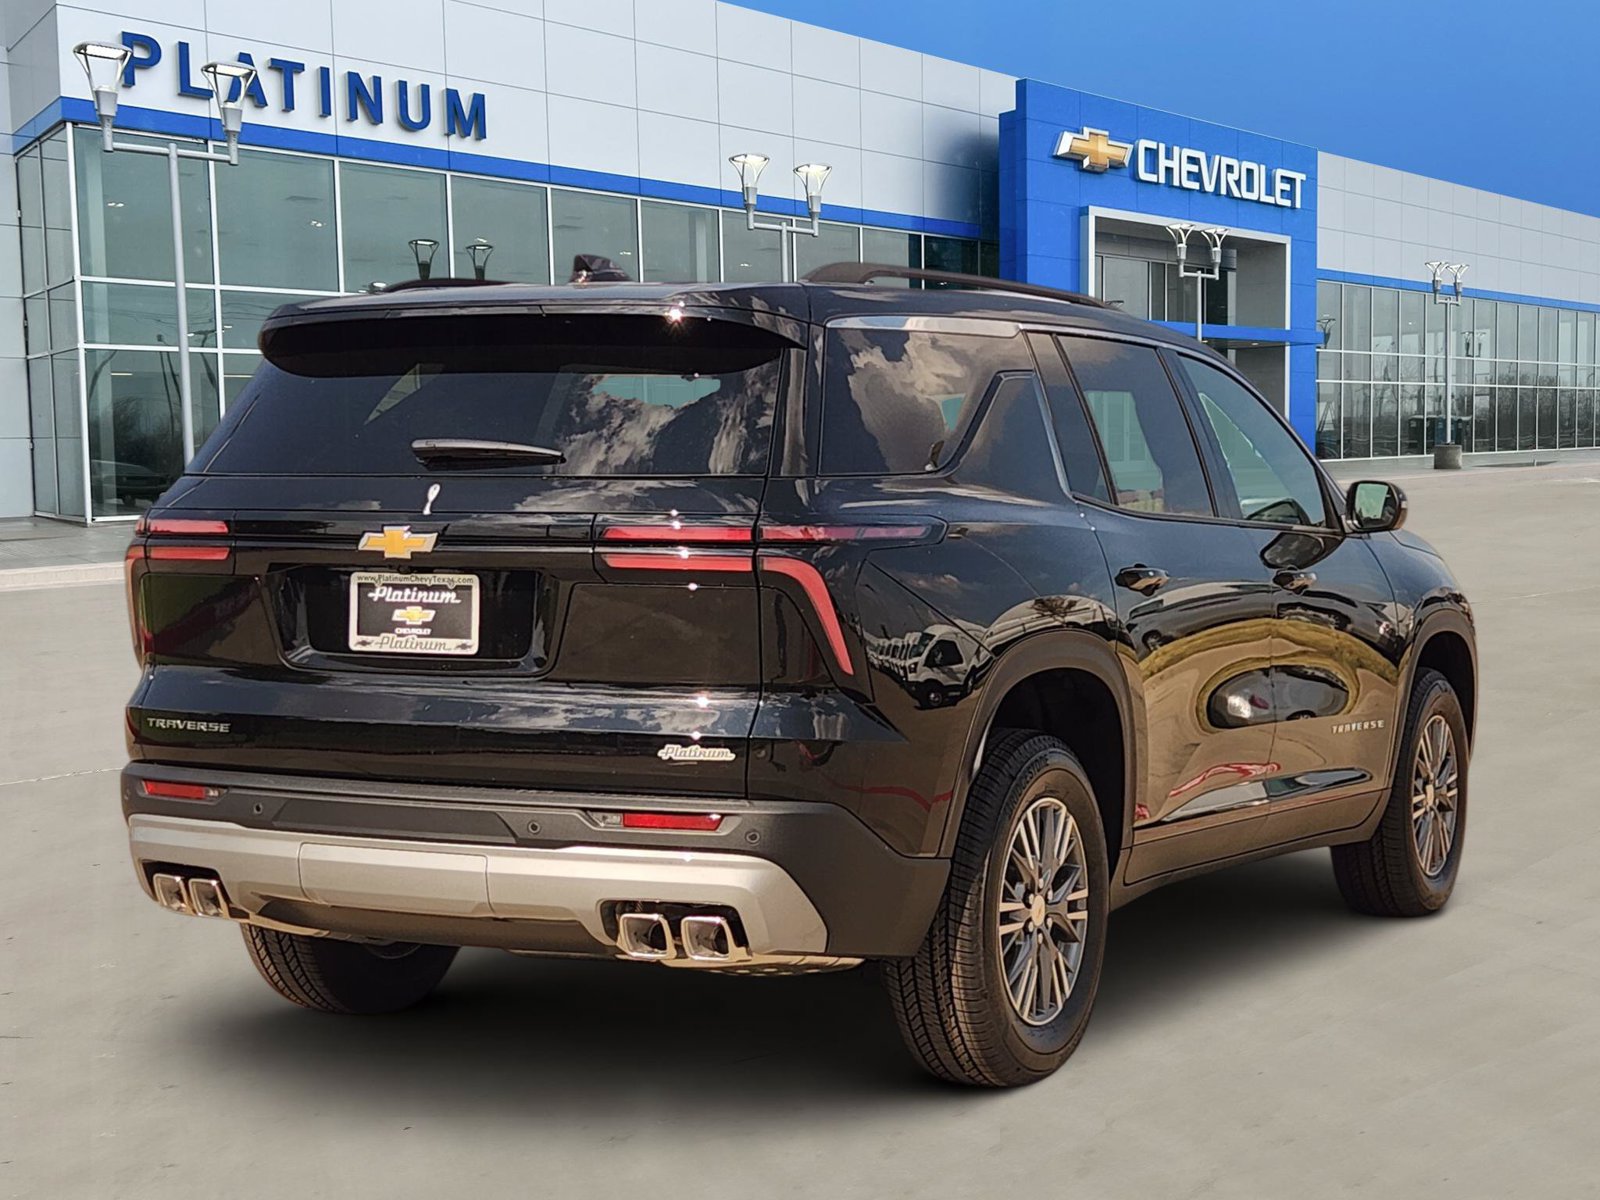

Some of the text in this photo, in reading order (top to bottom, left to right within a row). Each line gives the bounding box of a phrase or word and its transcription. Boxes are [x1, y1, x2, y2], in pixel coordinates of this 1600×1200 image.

[120, 30, 487, 141] PLATINUM
[1136, 138, 1307, 209] CHEVROLET
[367, 585, 462, 604] Platinum
[375, 635, 452, 651] Platinum
[146, 717, 232, 733] TRAVERSE
[1332, 720, 1385, 734] TRAVERSE
[658, 744, 736, 761] Platinum
